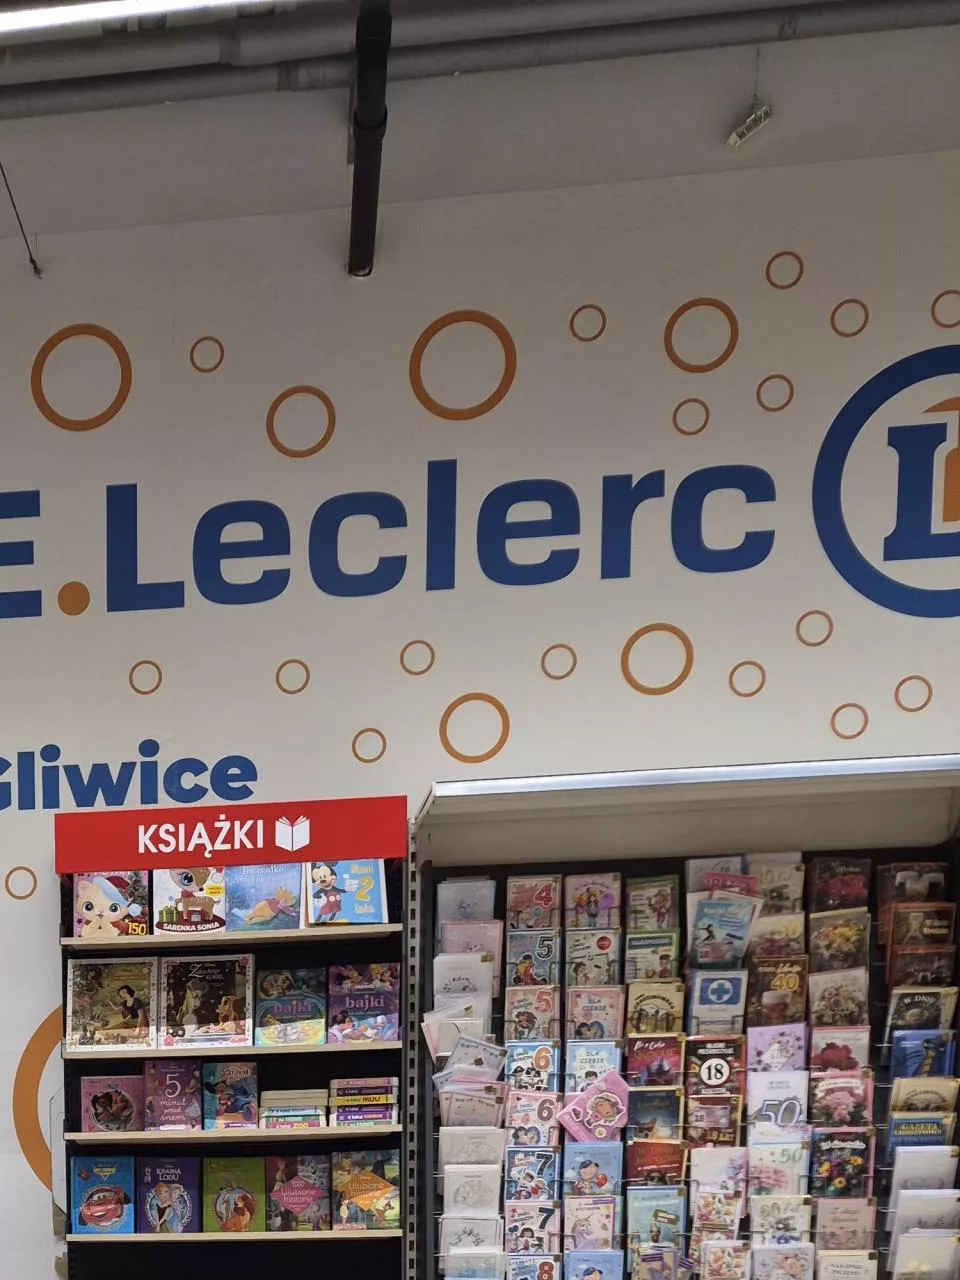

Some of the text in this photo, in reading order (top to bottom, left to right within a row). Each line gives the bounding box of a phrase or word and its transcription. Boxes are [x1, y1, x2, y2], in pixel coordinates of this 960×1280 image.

[138, 814, 264, 858] KSIĄŻKI
[355, 876, 375, 901] 2
[534, 882, 553, 907] 4
[128, 921, 146, 936] 150
[162, 921, 220, 932] SARENKA SONIA
[536, 934, 554, 960] 5
[770, 973, 800, 992] 40
[345, 995, 384, 1011] bajki
[534, 989, 553, 1013] 5
[533, 1045, 553, 1071] 6
[705, 1063, 724, 1081] 18
[165, 1073, 181, 1098] 5
[536, 1098, 555, 1121] 6
[760, 1098, 802, 1127] 50
[535, 1152, 554, 1177] 7
[538, 1206, 555, 1230] 7
